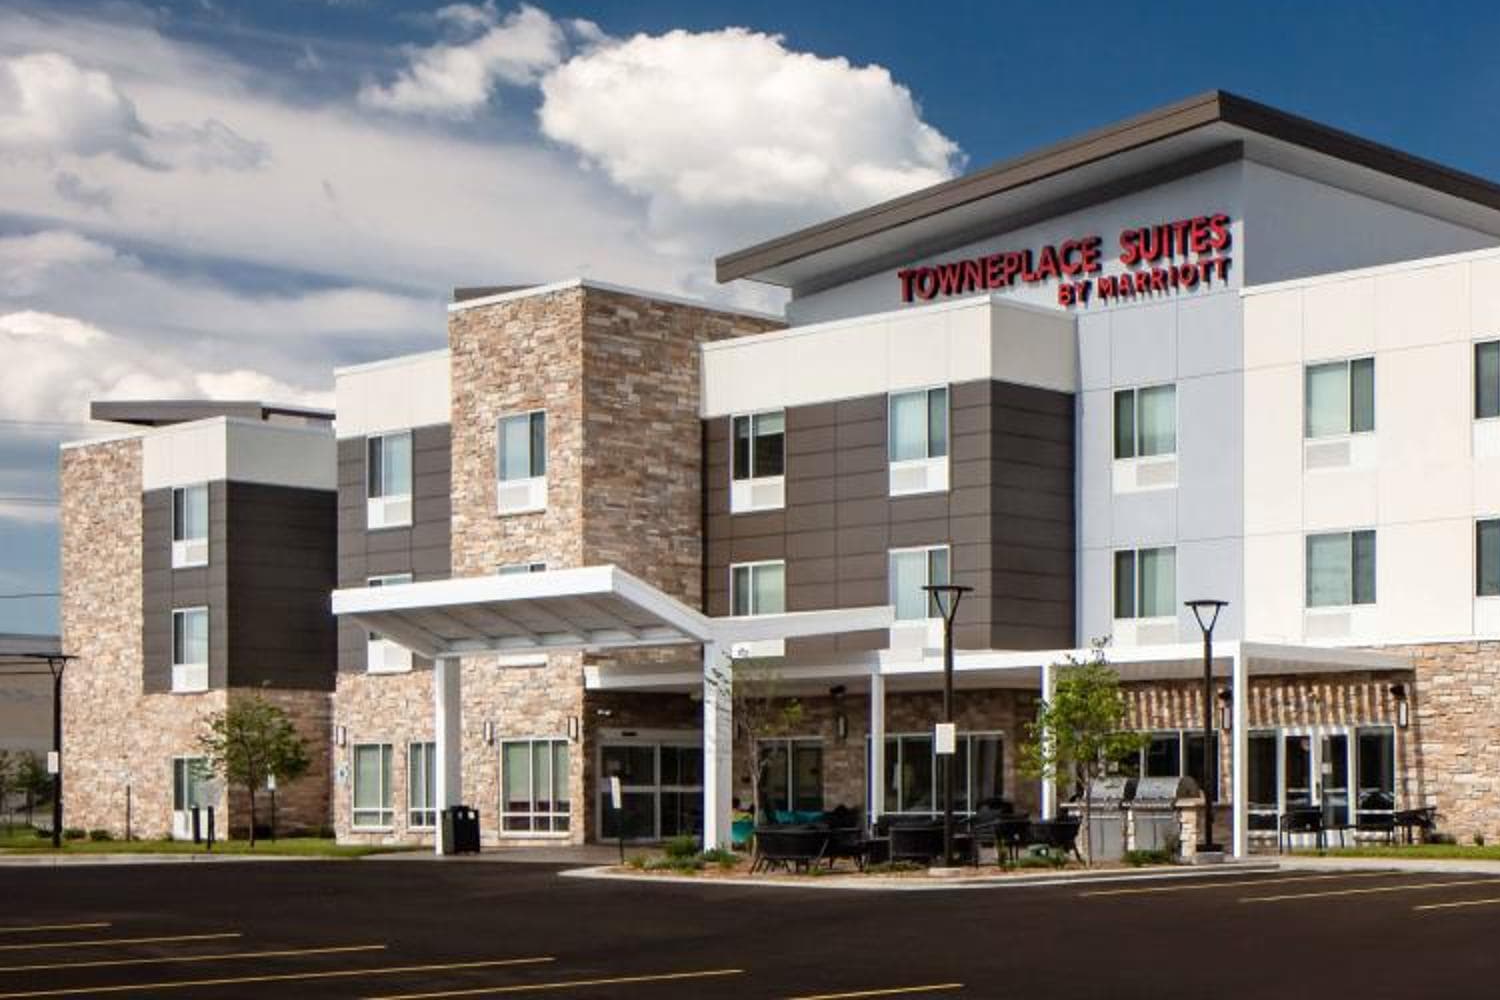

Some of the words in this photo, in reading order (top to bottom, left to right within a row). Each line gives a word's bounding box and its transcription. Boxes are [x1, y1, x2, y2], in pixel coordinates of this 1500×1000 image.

[898, 237, 1101, 301] TOWNEPLACE
[1119, 214, 1230, 264] SUITES
[1057, 281, 1091, 306] BY
[1097, 258, 1231, 298] MARRIOTT
